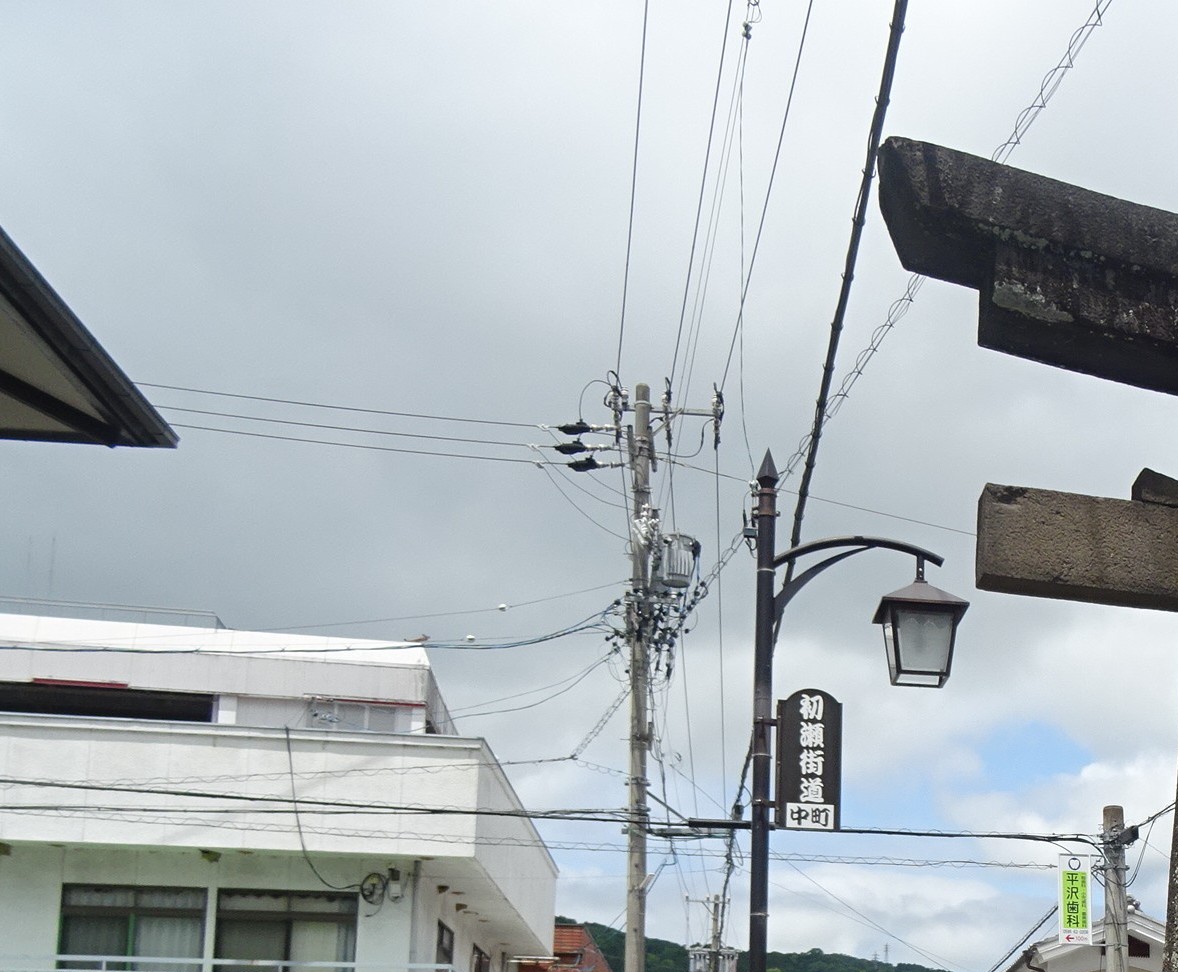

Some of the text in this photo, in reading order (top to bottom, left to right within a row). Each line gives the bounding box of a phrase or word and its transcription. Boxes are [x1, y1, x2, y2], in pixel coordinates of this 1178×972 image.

[799, 694, 825, 803] 初瀬街道
[790, 806, 831, 826] 中町
[1066, 872, 1080, 928] 平沢歯科
